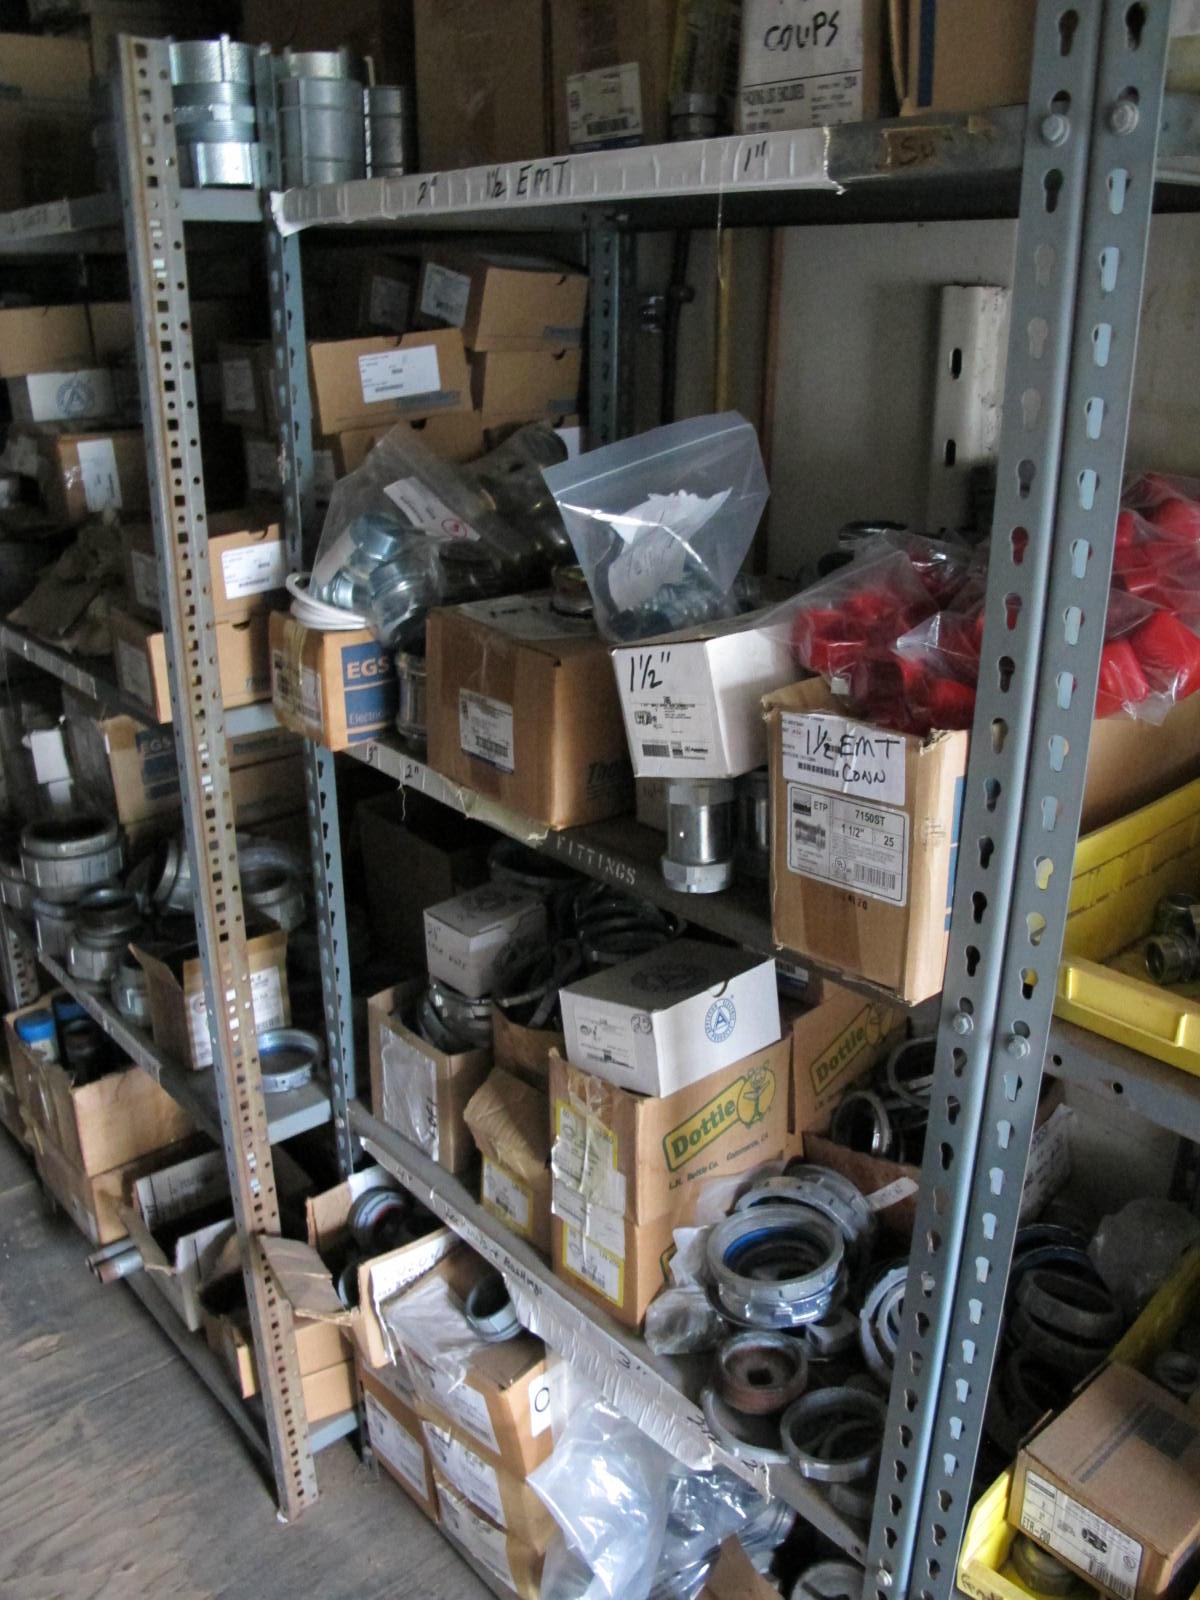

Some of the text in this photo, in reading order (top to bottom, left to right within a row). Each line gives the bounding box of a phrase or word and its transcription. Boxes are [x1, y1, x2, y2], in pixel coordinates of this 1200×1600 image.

[763, 9, 840, 52] COUPS
[346, 656, 390, 680] EGS
[839, 733, 901, 759] EMT
[813, 800, 828, 811] ETP
[855, 809, 886, 827] 7150ST
[883, 835, 895, 848] 25
[556, 835, 637, 886] FITTINGS
[671, 1099, 736, 1158] Dottie
